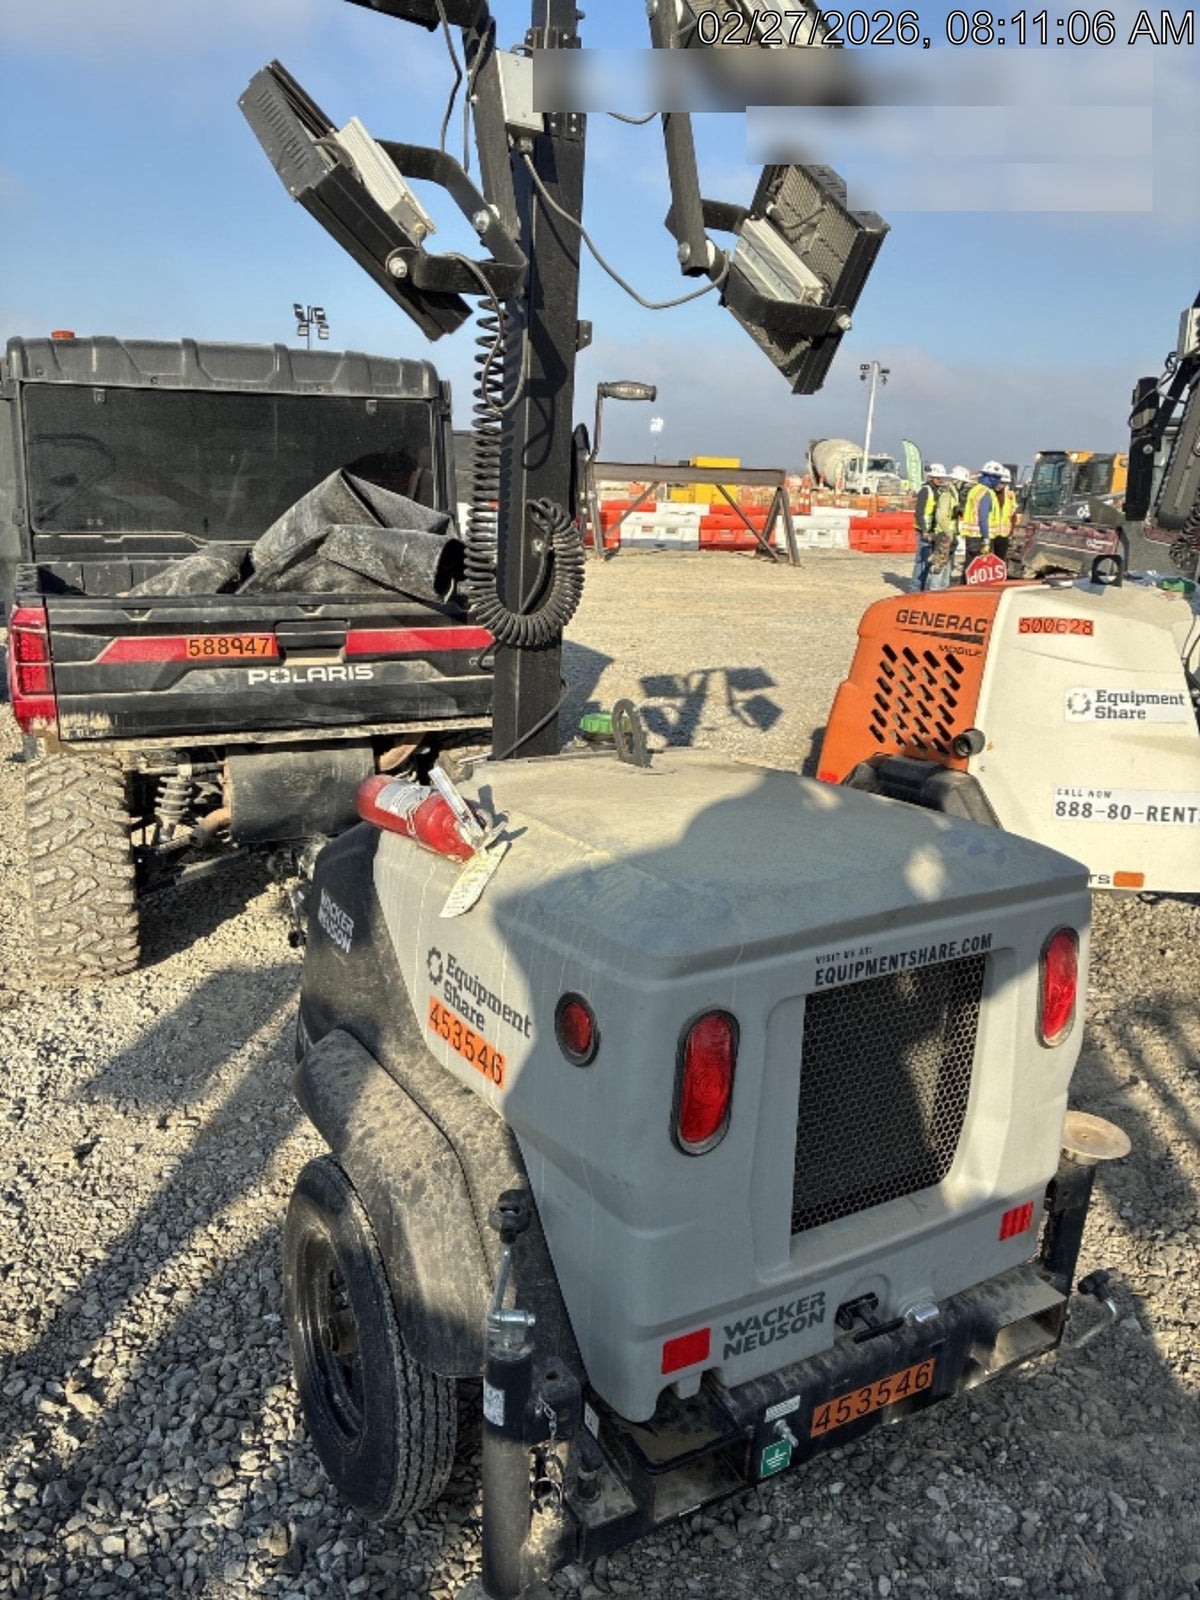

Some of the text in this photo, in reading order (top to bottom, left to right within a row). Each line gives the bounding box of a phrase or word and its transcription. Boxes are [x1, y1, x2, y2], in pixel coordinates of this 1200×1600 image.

[967, 564, 1005, 585] STOP
[895, 609, 988, 634] GENERAC
[1019, 618, 1093, 636] 500628
[188, 637, 270, 658] 588947
[248, 665, 374, 686] POLARIS
[1095, 689, 1185, 707] Equipment
[1095, 706, 1146, 720] Share
[1057, 788, 1112, 799] CALL NOW
[1055, 801, 1200, 824] 888-80-RENT
[814, 933, 992, 987] EQUIPMENTSHARE.COM
[443, 981, 485, 1032] Share
[445, 953, 532, 1039] Equipment
[429, 1002, 505, 1087] 453546
[723, 1290, 826, 1341] WACKER
[722, 1308, 826, 1361] NEUSON
[813, 1362, 932, 1431] 453546
